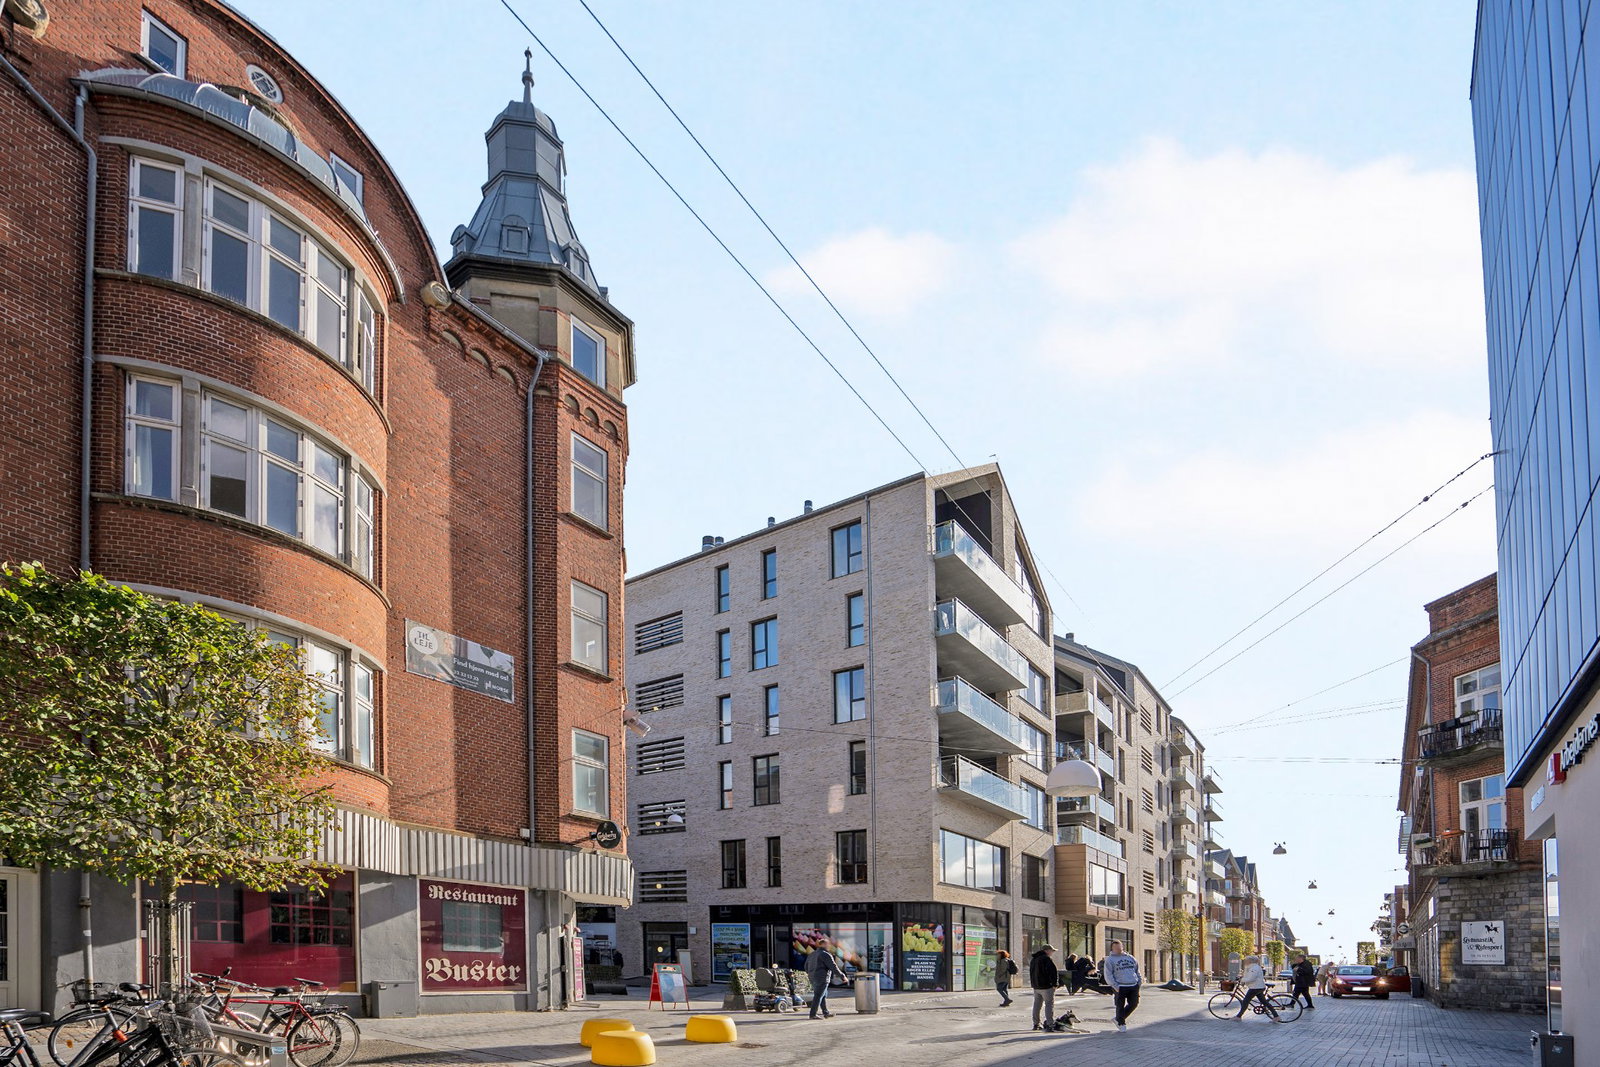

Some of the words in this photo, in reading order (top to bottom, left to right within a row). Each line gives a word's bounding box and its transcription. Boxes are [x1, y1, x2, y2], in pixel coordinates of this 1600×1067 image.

[414, 638, 433, 650] LEJE
[417, 631, 429, 641] TIL
[453, 657, 468, 668] Find
[468, 662, 485, 674] hjem
[485, 668, 499, 679] med
[428, 884, 518, 906] Restaurant
[425, 958, 521, 982] Buster
